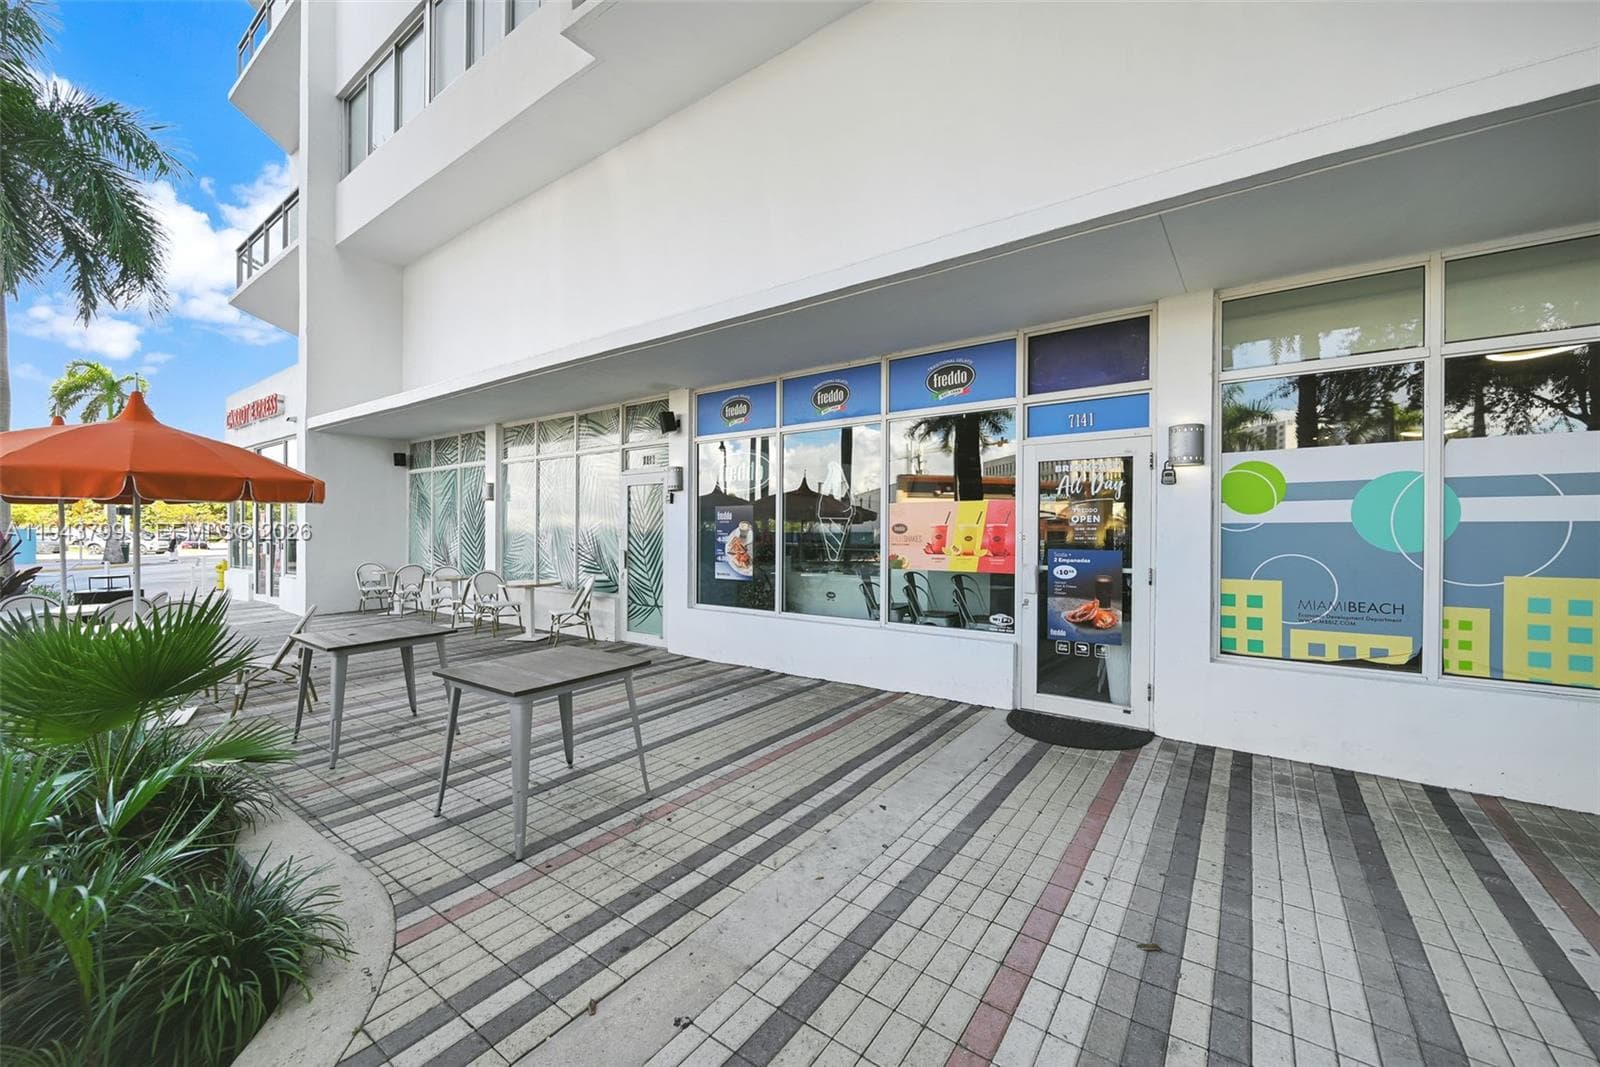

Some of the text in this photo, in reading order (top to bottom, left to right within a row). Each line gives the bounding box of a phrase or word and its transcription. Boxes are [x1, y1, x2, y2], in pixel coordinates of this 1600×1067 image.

[933, 369, 967, 388] freddo
[817, 389, 844, 405] freddo
[725, 403, 748, 417] freddo
[1068, 412, 1094, 428] 7141
[1055, 472, 1127, 500] All Day
[1071, 515, 1101, 523] OPEN
